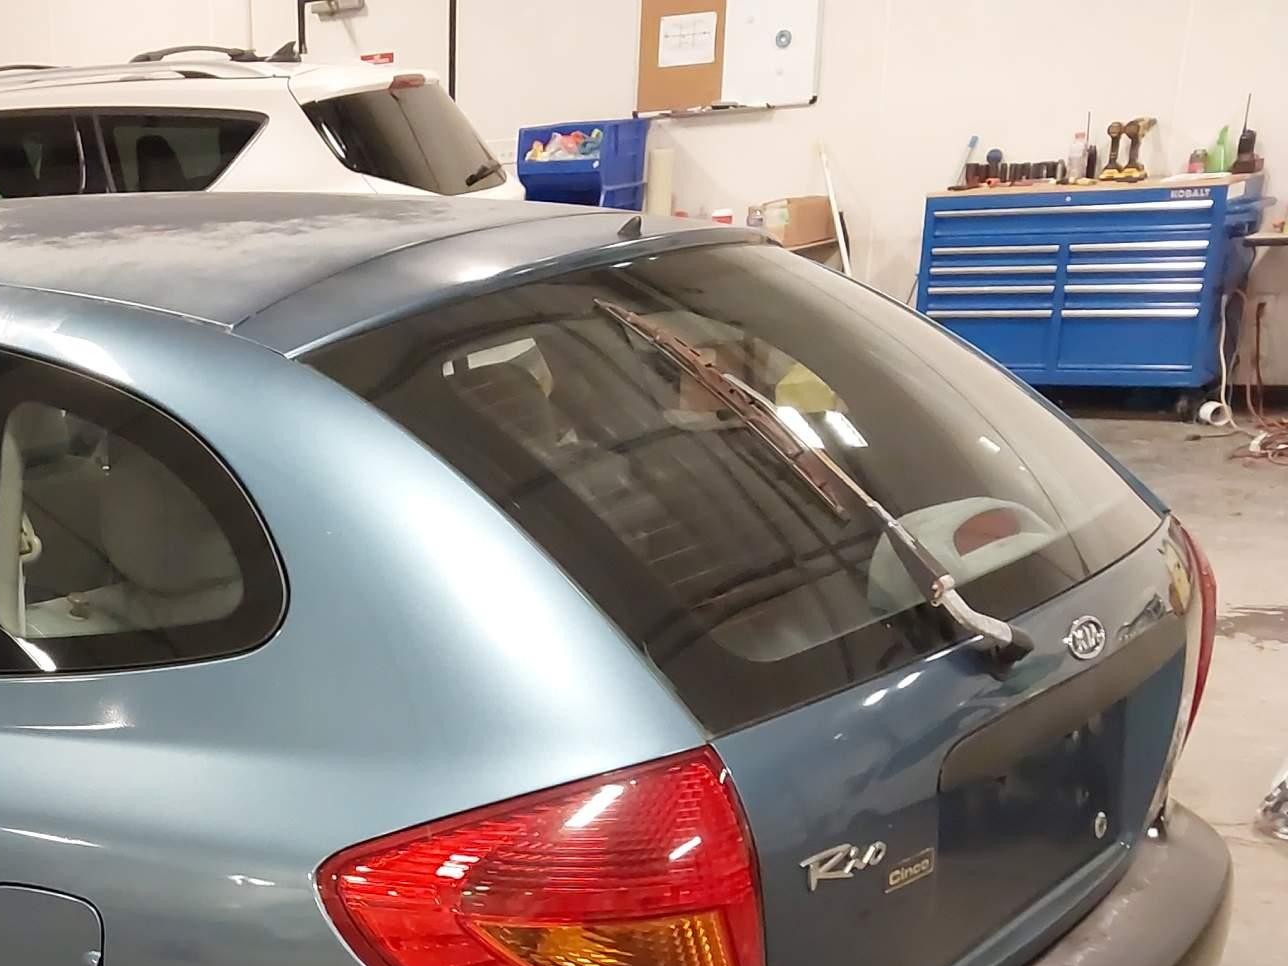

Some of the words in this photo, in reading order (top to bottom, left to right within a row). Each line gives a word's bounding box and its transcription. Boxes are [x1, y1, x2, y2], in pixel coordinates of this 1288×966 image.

[1170, 188, 1211, 198] KOBALT
[1071, 620, 1101, 654] KIA
[800, 841, 887, 891] Rio
[889, 858, 930, 885] Cinco
